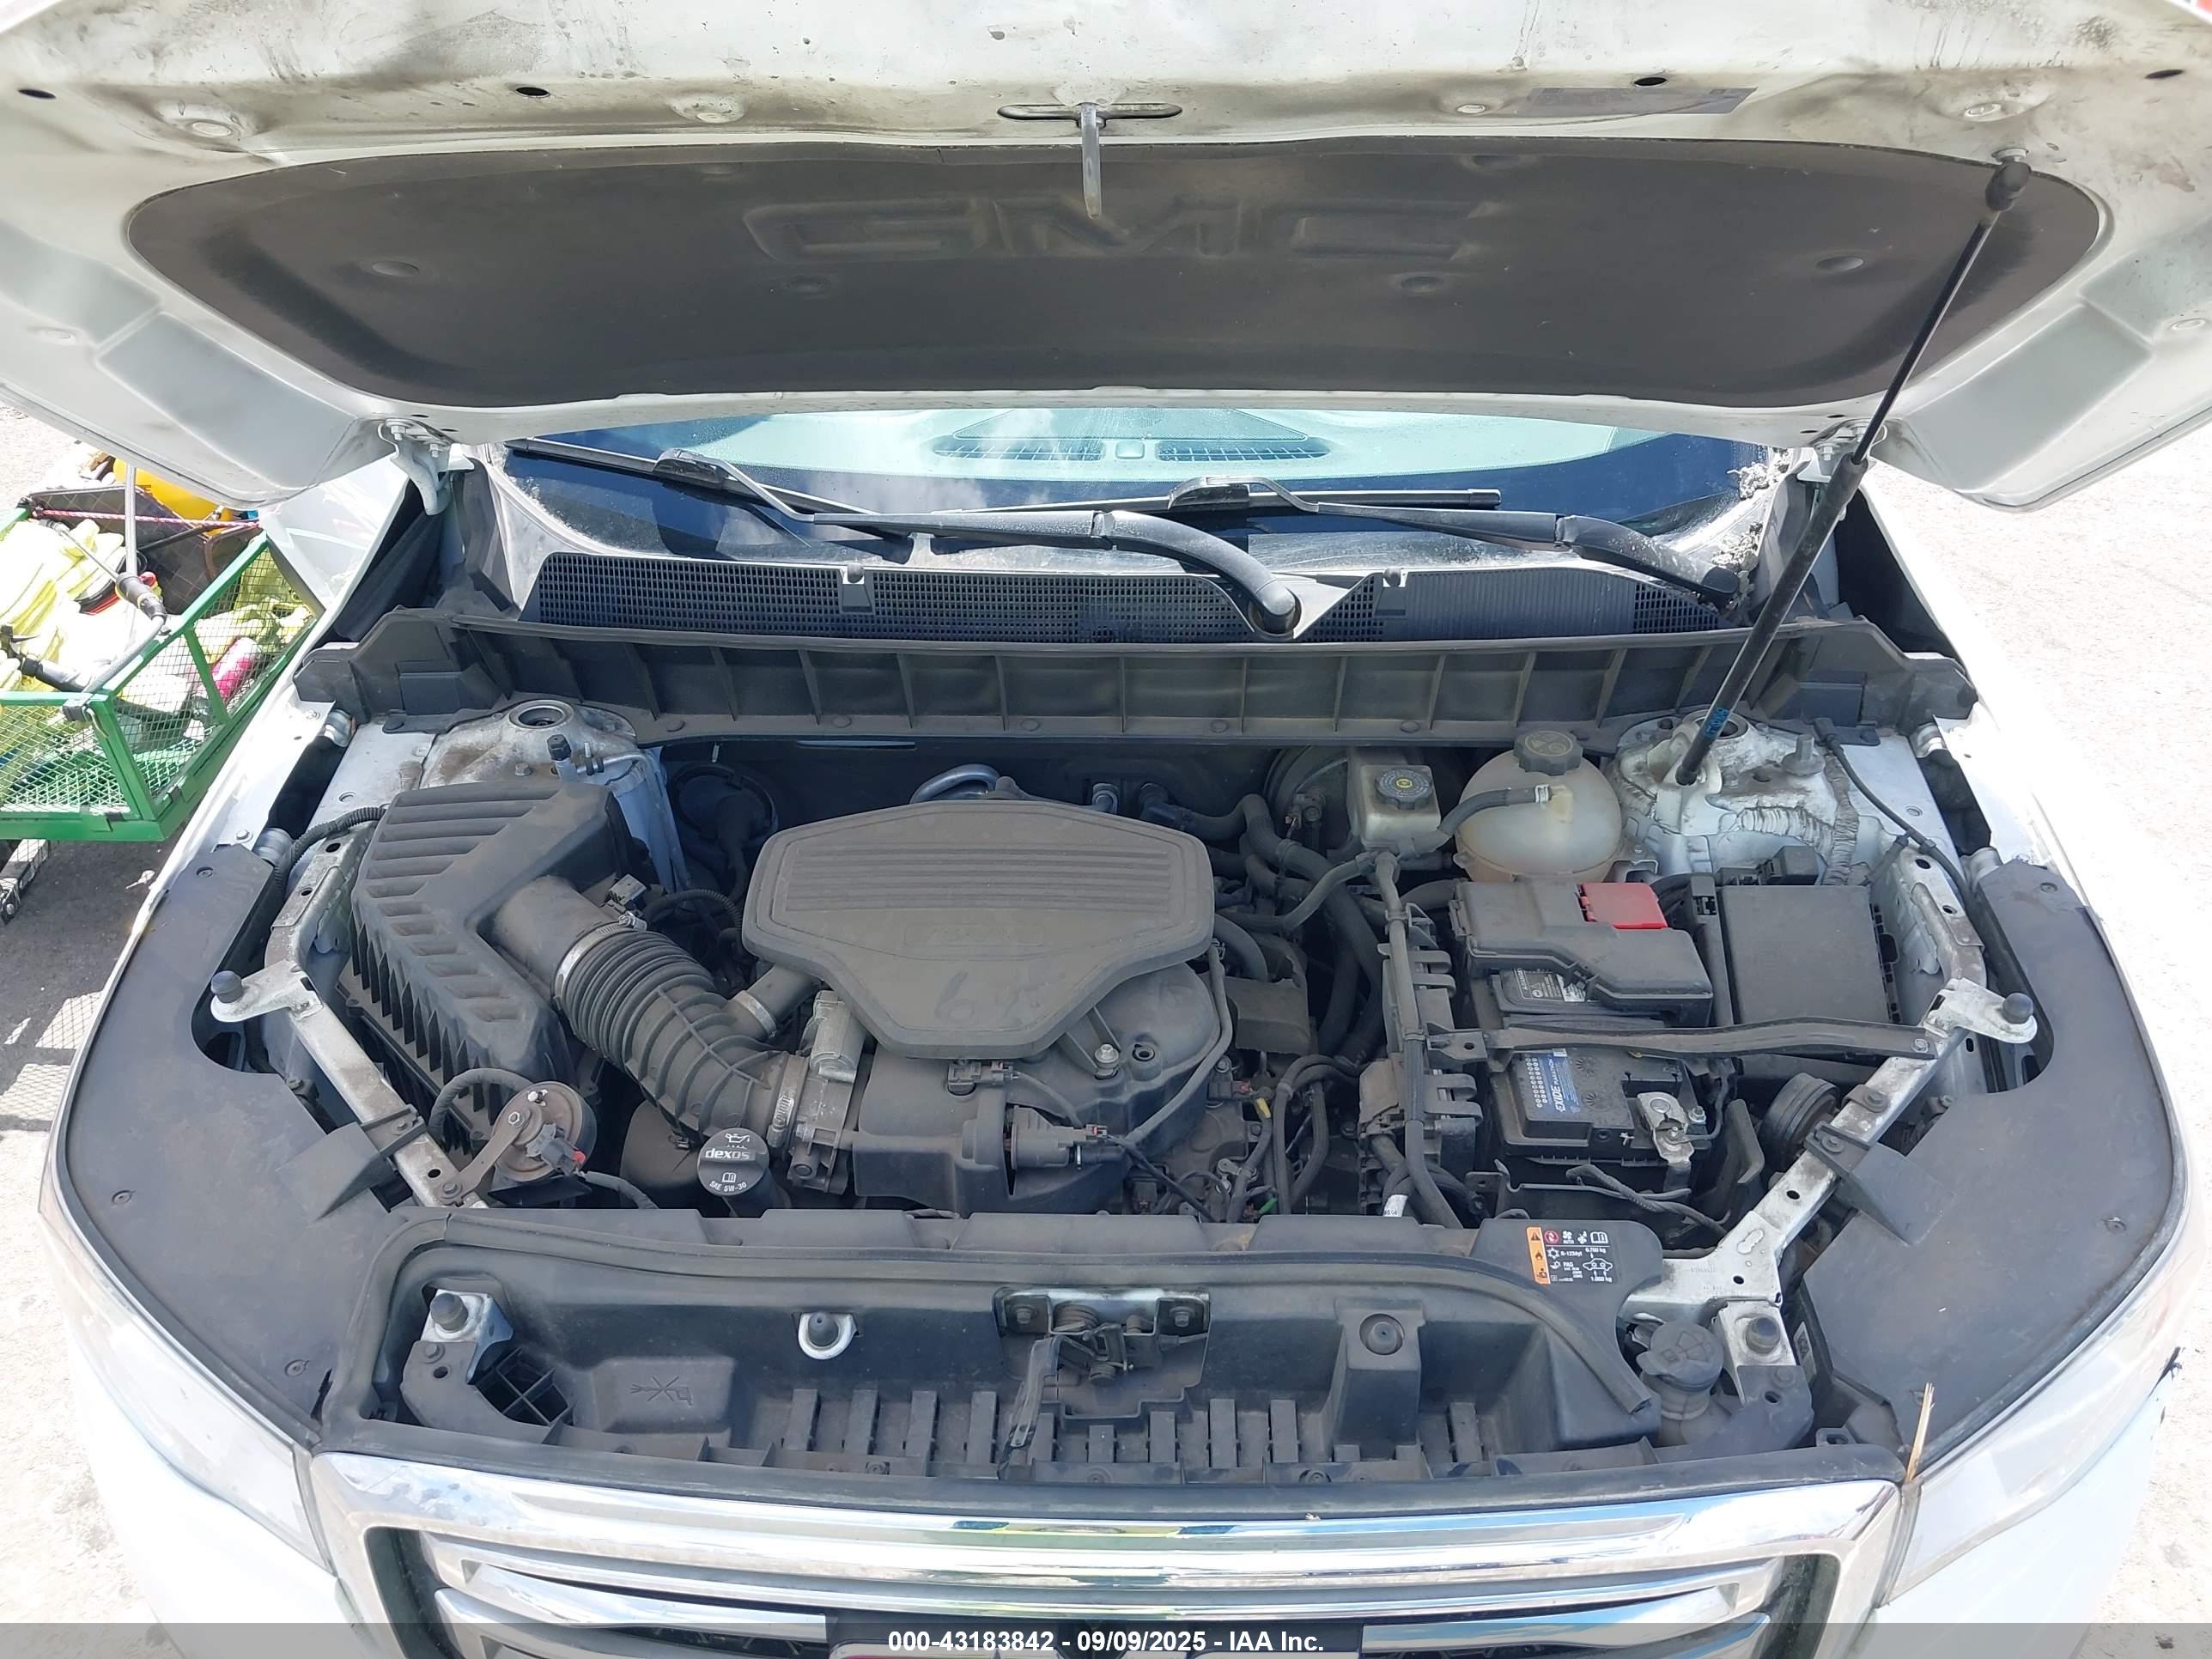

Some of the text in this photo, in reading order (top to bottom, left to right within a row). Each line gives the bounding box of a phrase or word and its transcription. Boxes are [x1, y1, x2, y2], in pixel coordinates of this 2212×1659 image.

[742, 197, 1507, 262] GMC
[1550, 1085, 1566, 1112] EXIDE
[705, 1148, 750, 1159] dexos
[709, 1181, 747, 1192] SAE 5W-30
